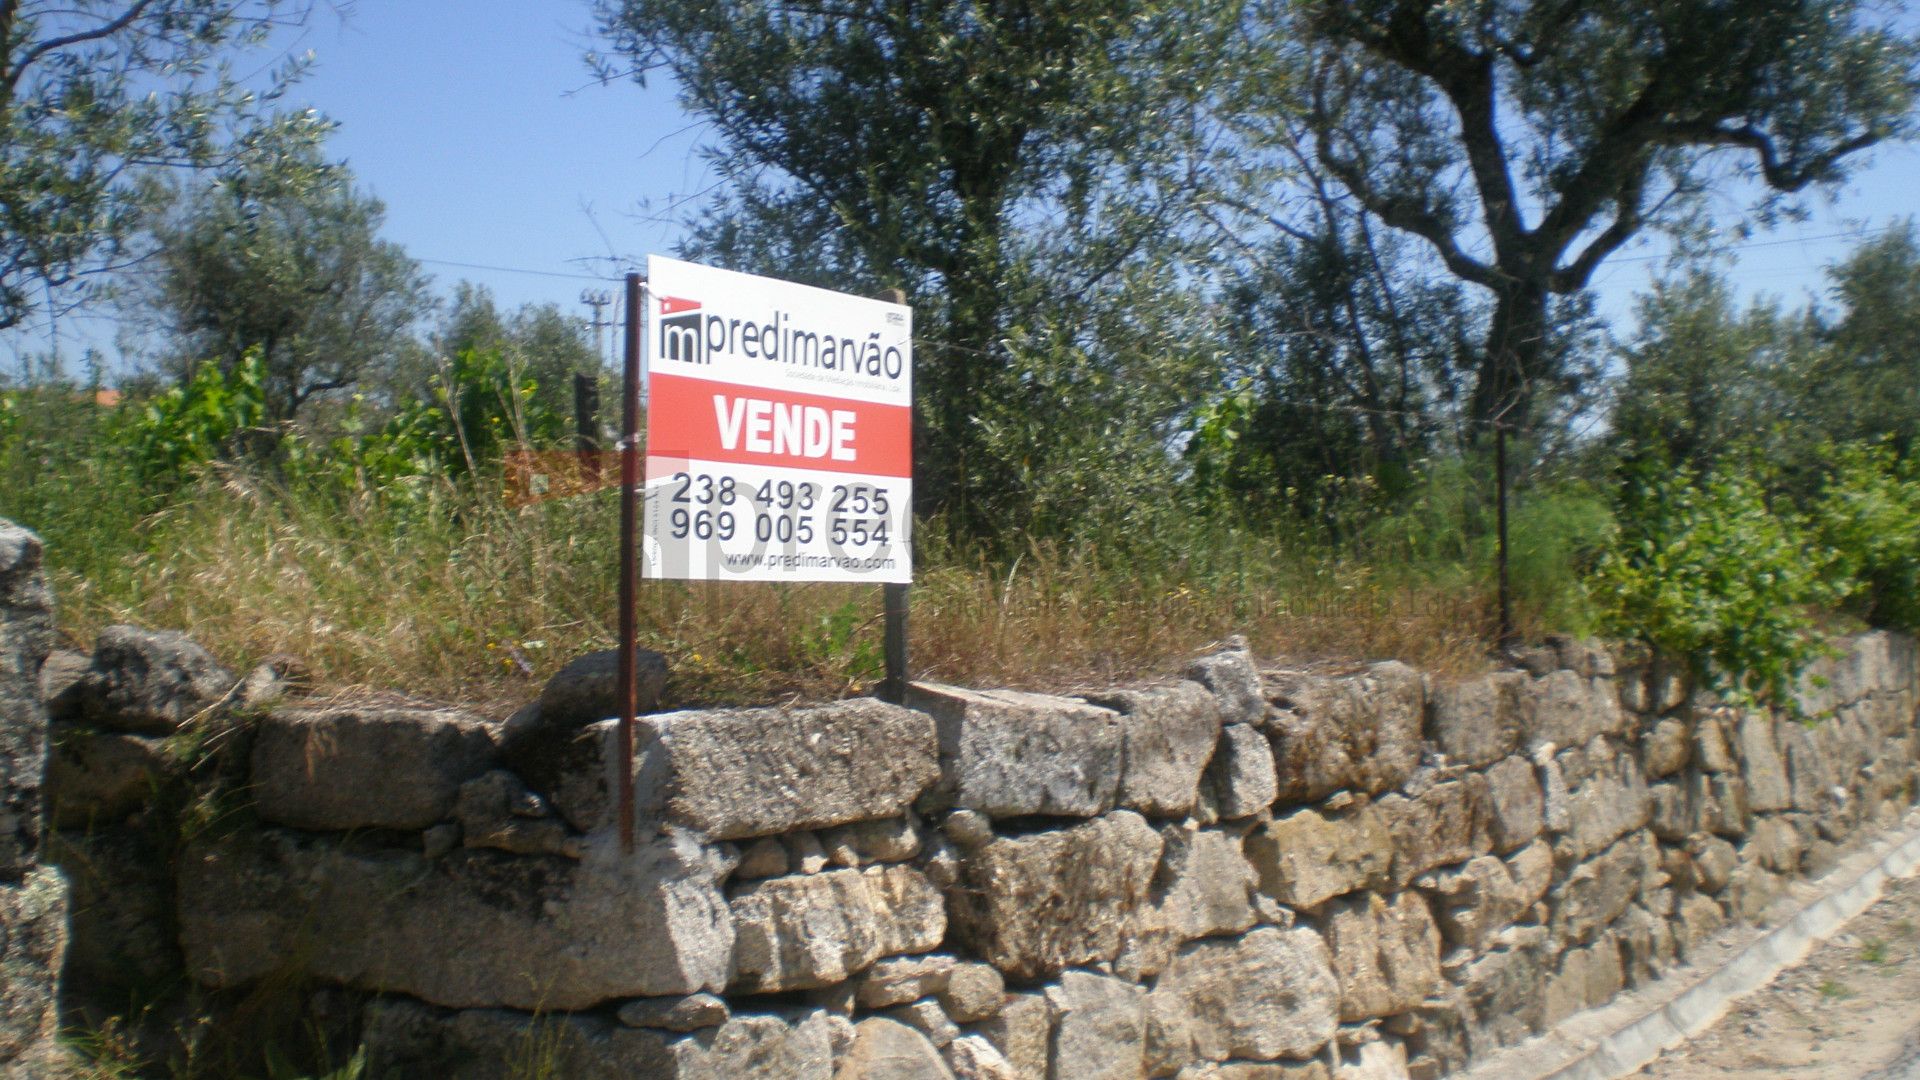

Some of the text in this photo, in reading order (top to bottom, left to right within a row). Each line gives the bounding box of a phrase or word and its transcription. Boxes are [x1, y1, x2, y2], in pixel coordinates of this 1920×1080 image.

[706, 310, 904, 380] predimarvão
[713, 394, 857, 461] VENDE
[672, 472, 889, 516] 238 493 255
[670, 507, 889, 547] 969 005 554
[724, 552, 896, 571] www.predimarvao.com
